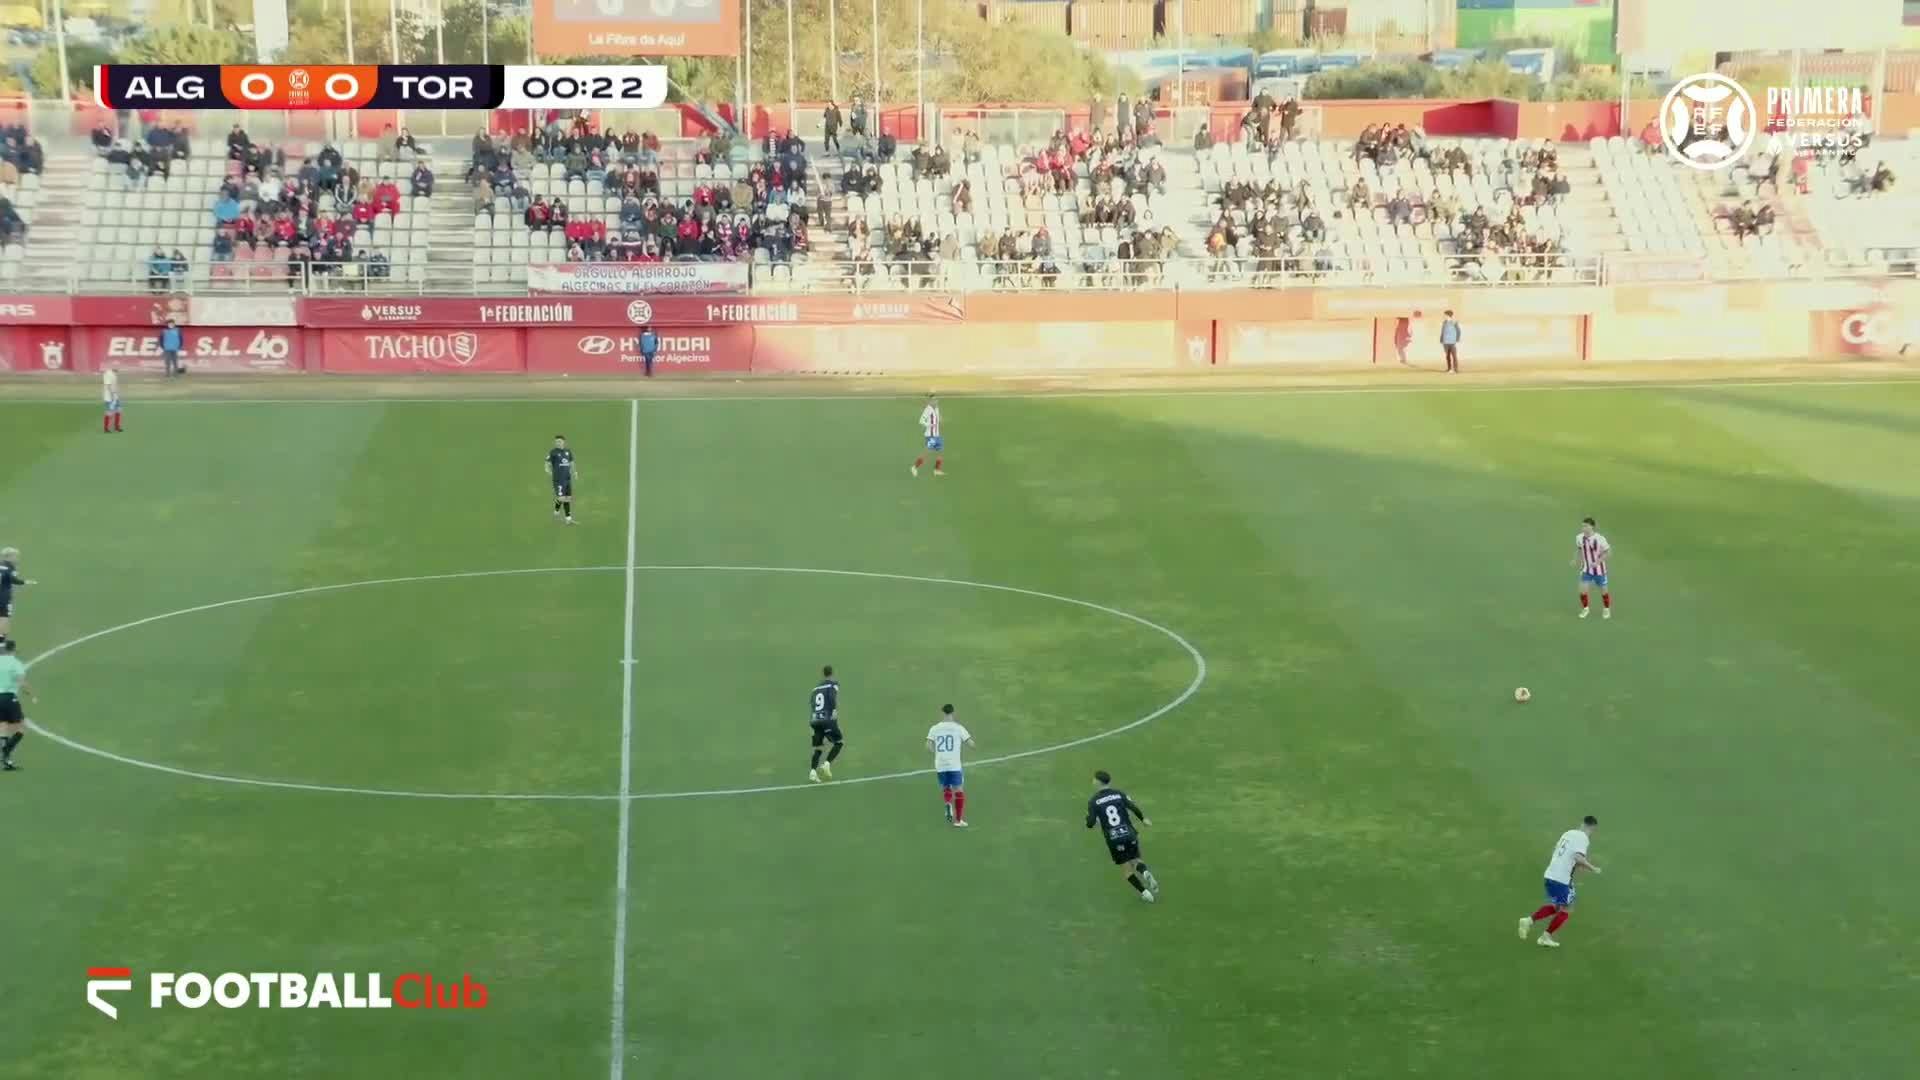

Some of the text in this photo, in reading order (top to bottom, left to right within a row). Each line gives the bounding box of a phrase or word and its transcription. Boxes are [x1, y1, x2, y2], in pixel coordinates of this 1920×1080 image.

[631, 267, 697, 279] ALBIRROJO
[372, 305, 422, 316] VERSUS
[495, 302, 573, 322] FEDERACIÓN
[195, 336, 241, 356] S.L.
[364, 335, 446, 359] TACHO
[666, 352, 710, 364] Algeciras
[815, 692, 825, 711] 9
[936, 734, 954, 753] 20
[1105, 805, 1121, 827] 8
